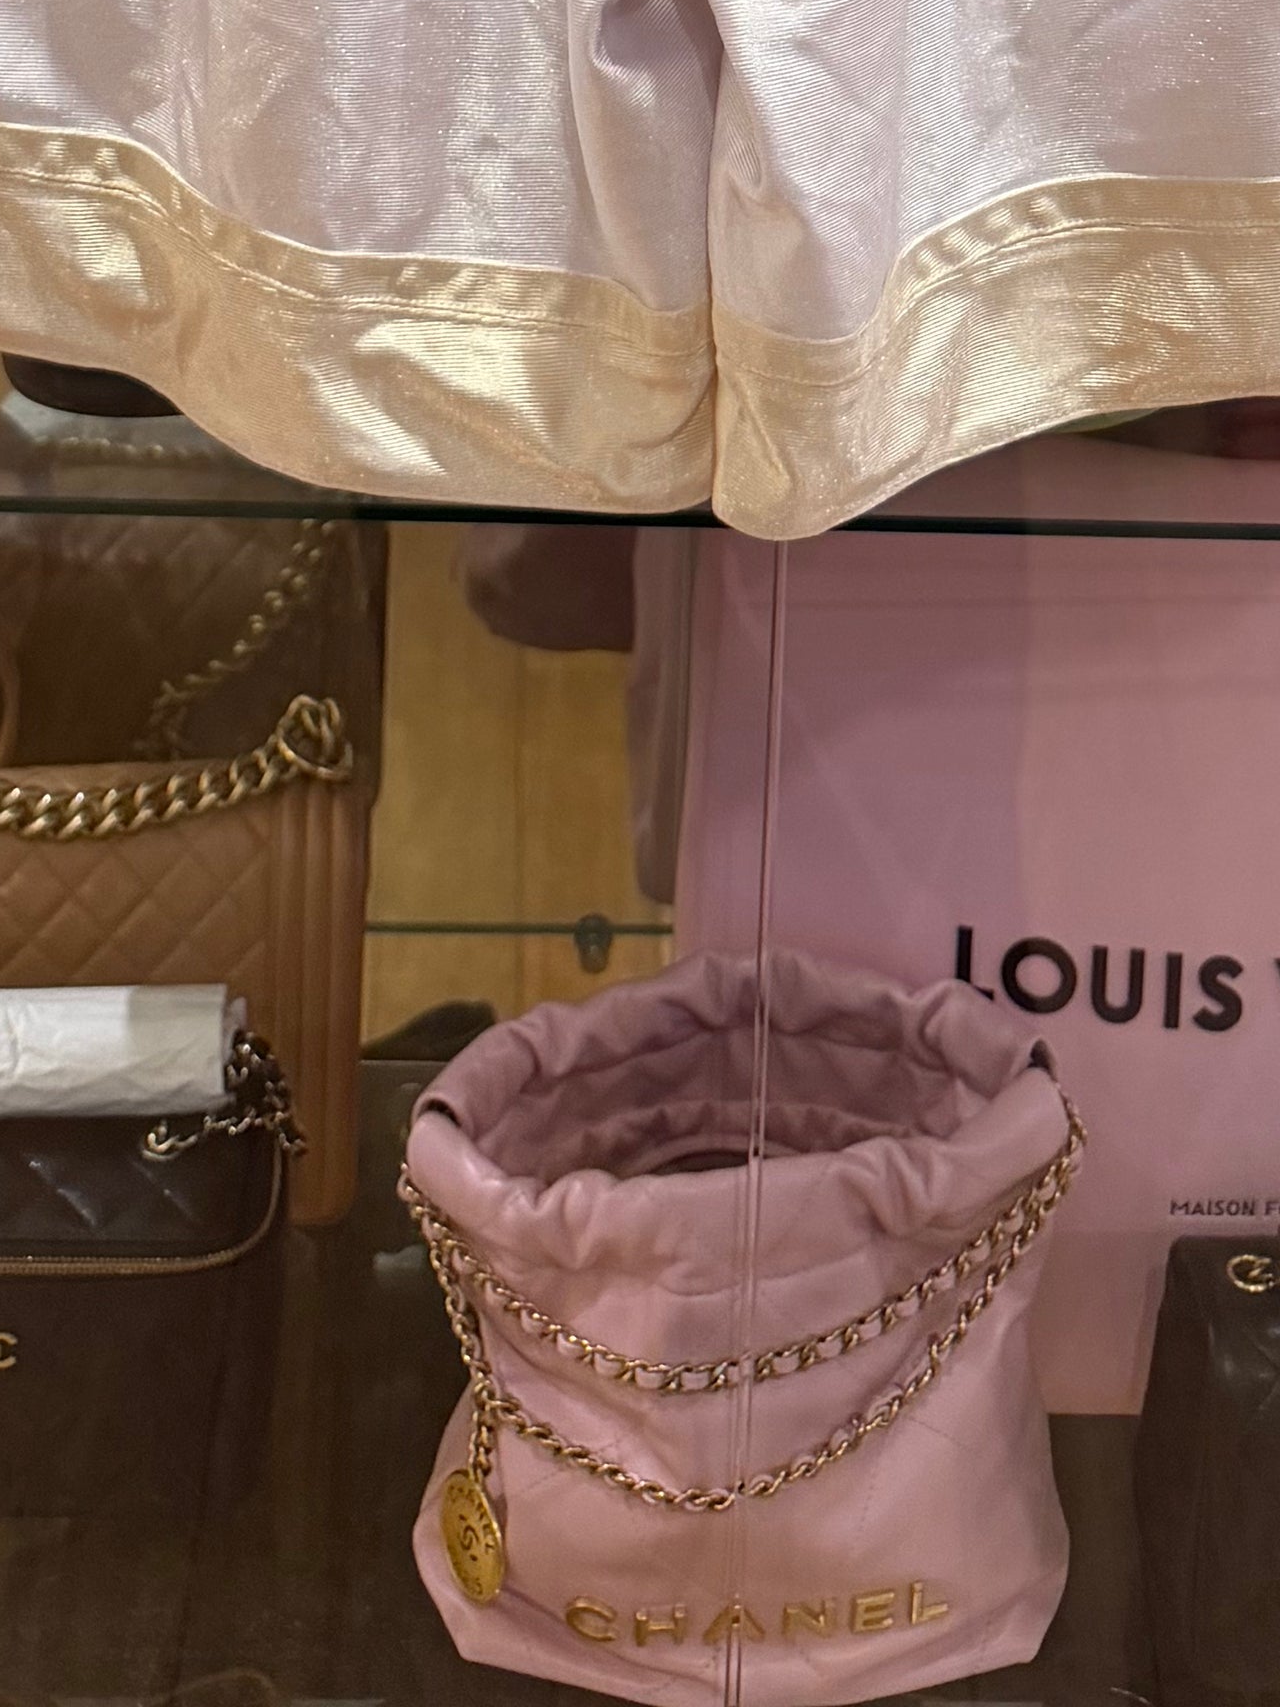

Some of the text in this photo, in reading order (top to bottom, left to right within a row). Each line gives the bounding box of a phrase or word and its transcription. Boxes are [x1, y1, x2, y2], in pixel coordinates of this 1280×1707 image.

[957, 925, 1244, 1033] LOUIS
[1168, 1198, 1256, 1217] MAISON
[565, 1580, 949, 1647] CHANEL
